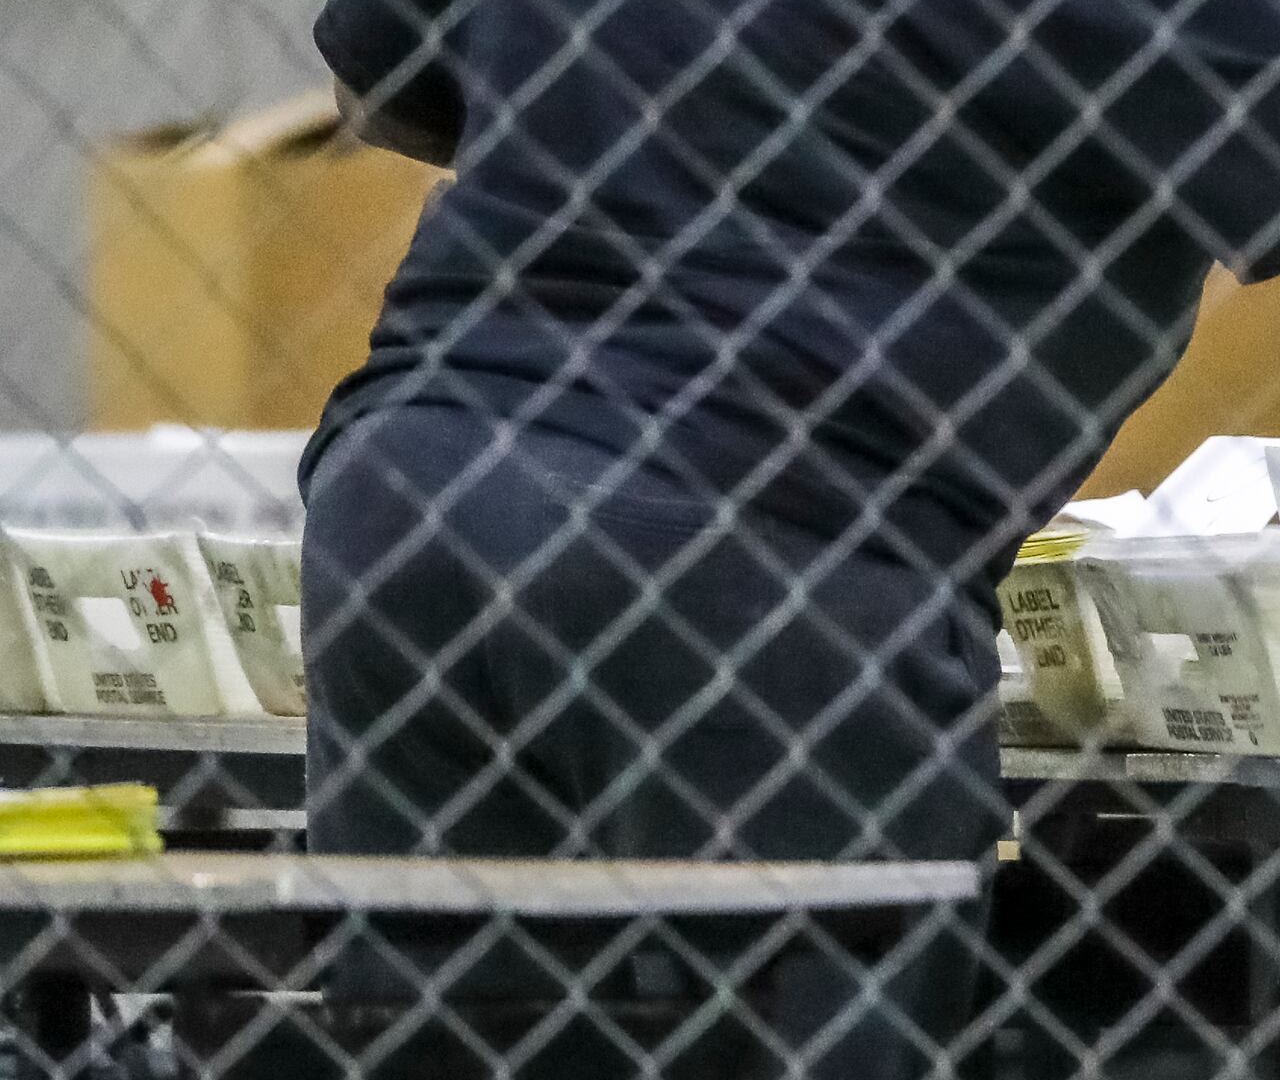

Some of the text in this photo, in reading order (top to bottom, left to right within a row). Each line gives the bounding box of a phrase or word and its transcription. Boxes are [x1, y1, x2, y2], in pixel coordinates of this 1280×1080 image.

[1008, 588, 1060, 613] LABEL
[146, 621, 178, 643] END
[1014, 616, 1067, 641] OTHER
